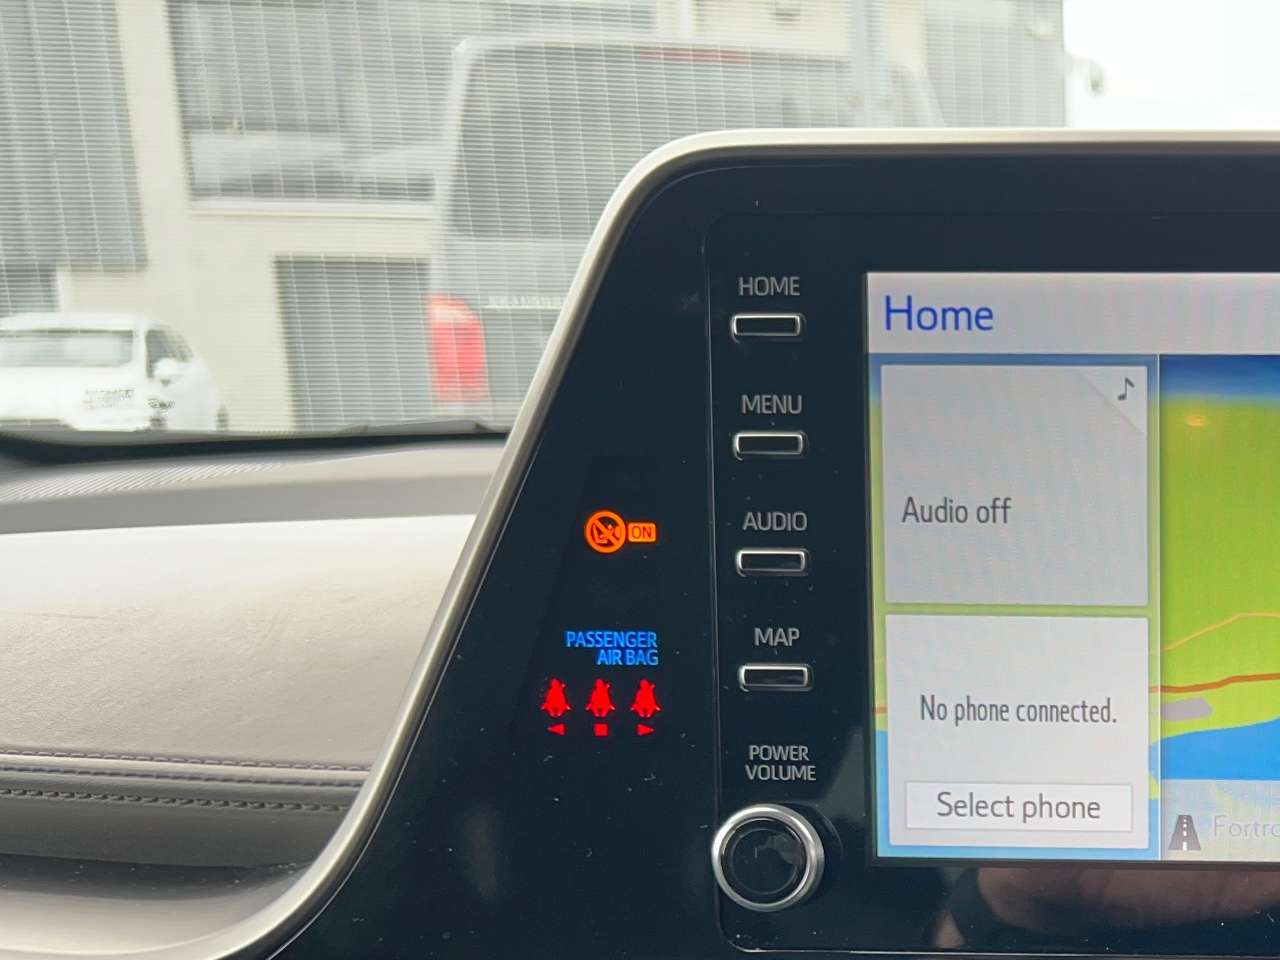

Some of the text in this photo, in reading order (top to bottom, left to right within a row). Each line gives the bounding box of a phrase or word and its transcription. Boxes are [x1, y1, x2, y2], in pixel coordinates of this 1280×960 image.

[738, 276, 801, 297] HOME
[884, 294, 995, 332] Home
[741, 394, 803, 415] MENU
[901, 496, 1013, 525] Audio off
[742, 511, 809, 532] AUDIO
[631, 525, 653, 540] ON
[565, 630, 659, 648] PASSENGER
[753, 627, 801, 647] MAP
[596, 649, 660, 666] AIR BAG
[919, 694, 1118, 727] No phone connected.
[748, 744, 811, 762] POWER
[744, 764, 818, 782] VOLUME
[936, 791, 1101, 825] Select phone
